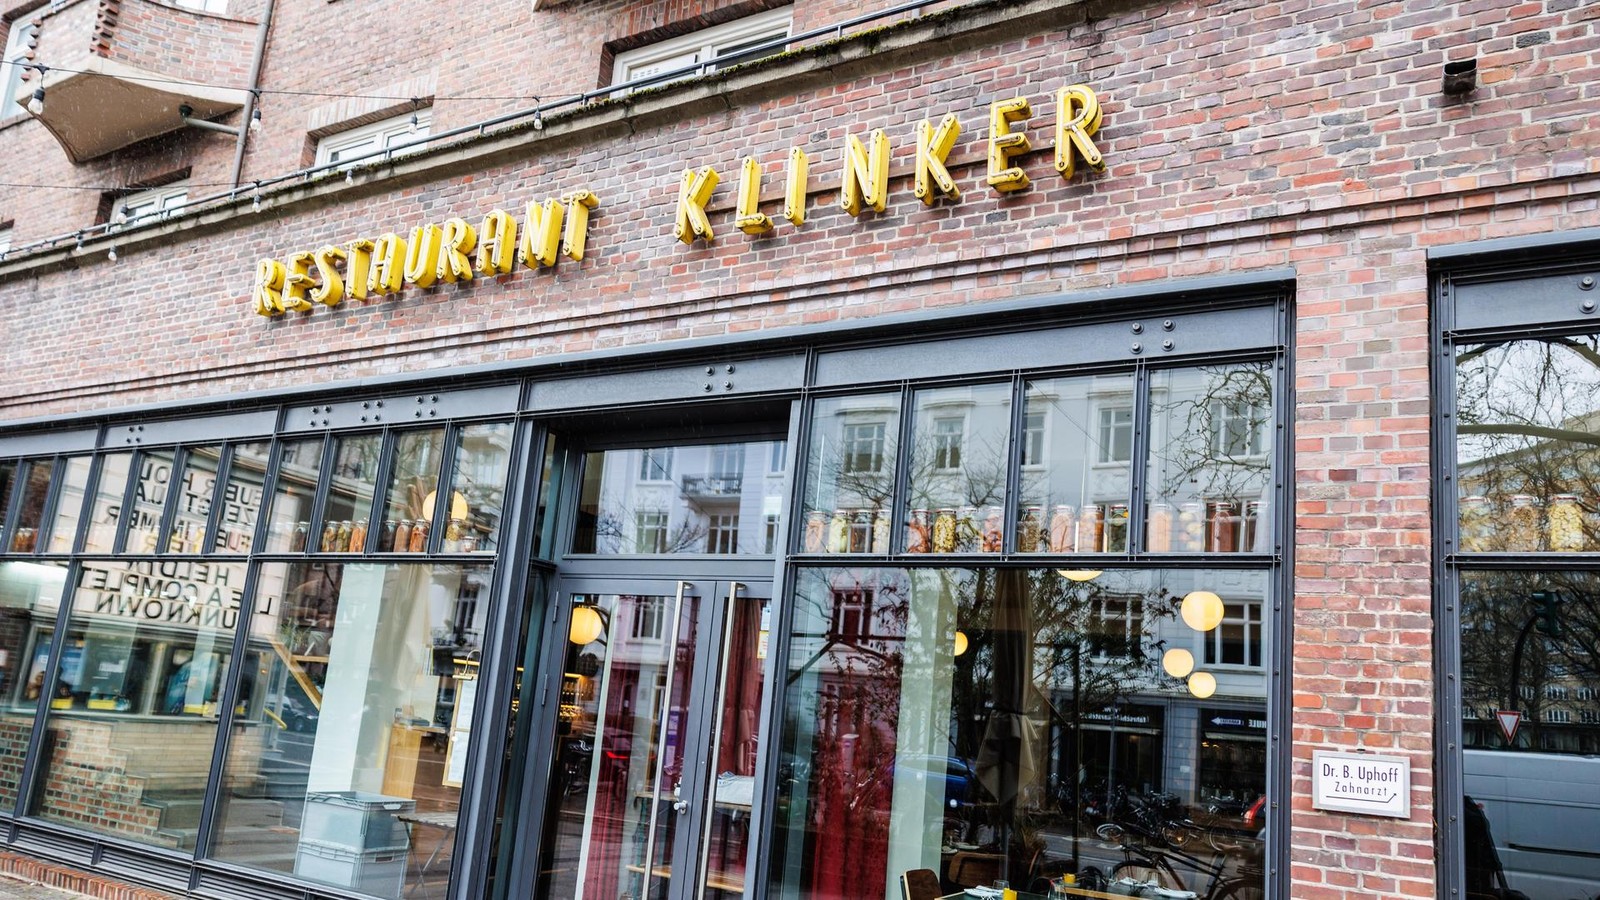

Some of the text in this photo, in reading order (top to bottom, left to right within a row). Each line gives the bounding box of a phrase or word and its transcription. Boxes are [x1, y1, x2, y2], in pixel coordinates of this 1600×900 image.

[253, 84, 1106, 317] RESTAURANT KLINKER
[1323, 763, 1398, 783] Dr. B. Uphoff
[1335, 781, 1387, 796] Zahnarzt
